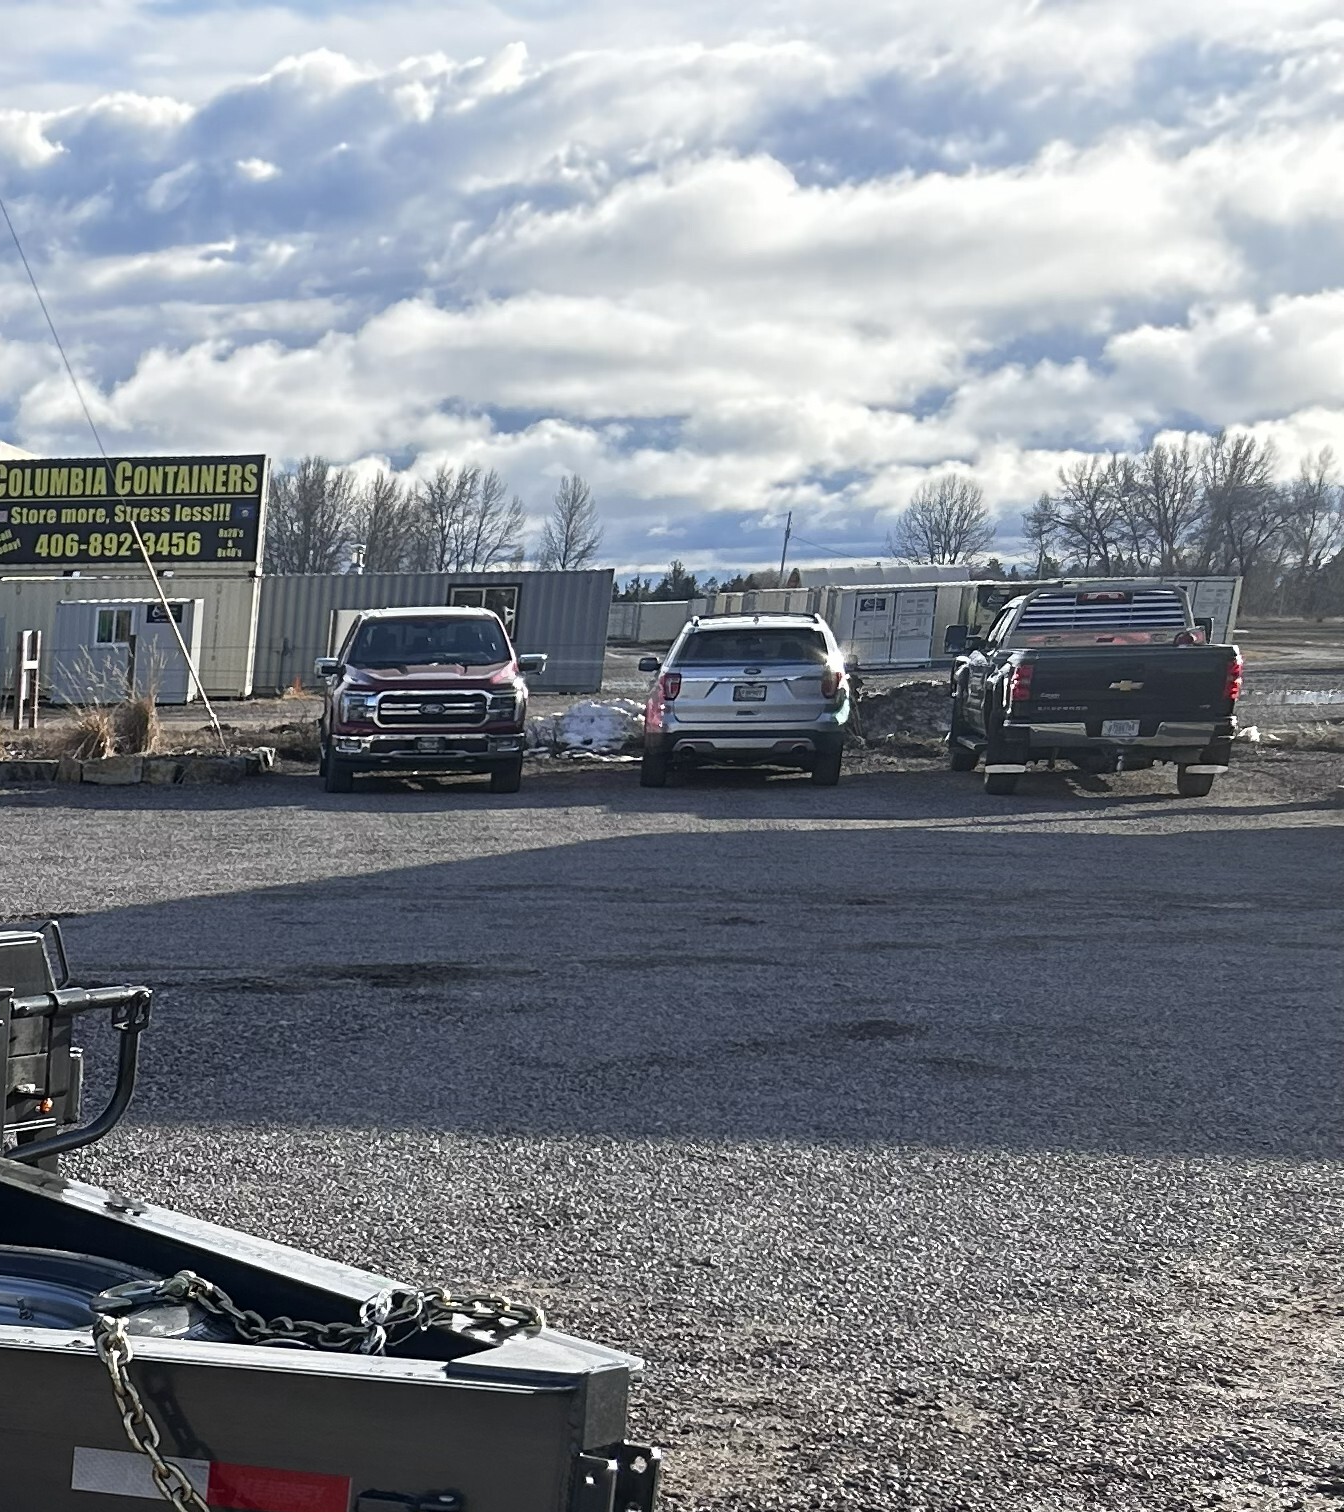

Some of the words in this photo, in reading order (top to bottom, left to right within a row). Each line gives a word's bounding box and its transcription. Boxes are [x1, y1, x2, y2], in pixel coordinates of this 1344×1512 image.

[114, 460, 259, 496] CONTAINERS
[10, 506, 58, 525] Store
[60, 507, 111, 525] more,
[113, 504, 171, 523] Stress
[173, 503, 232, 522] less!!!
[34, 531, 202, 558] 406-892-3456
